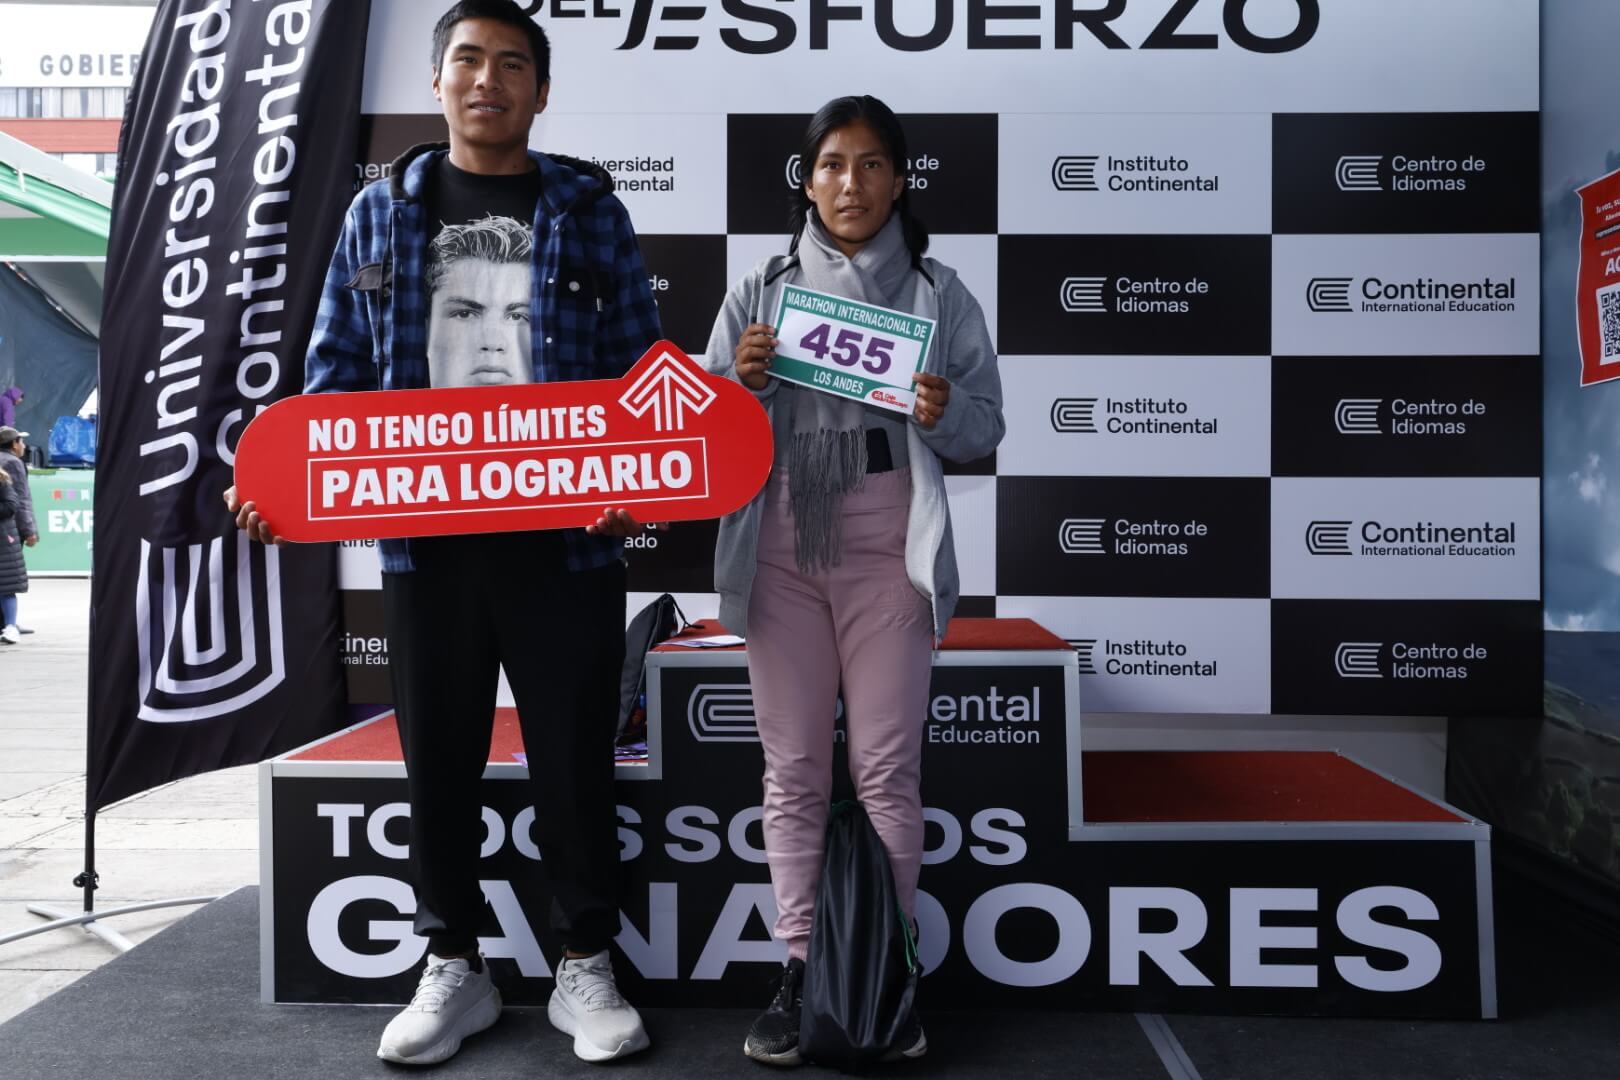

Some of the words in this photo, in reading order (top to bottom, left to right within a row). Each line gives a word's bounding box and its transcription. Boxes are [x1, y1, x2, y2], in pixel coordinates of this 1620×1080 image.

[613, 0, 1320, 54] ESFUERZO
[916, 155, 939, 170] de
[1109, 156, 1188, 171] Instituto
[1392, 156, 1457, 171] Centro
[1462, 156, 1485, 171] de
[613, 176, 674, 191] inental
[1108, 175, 1218, 191] Continental
[1393, 175, 1465, 190] Idiomas
[137, 0, 231, 496] Universidad
[1117, 277, 1180, 293] Centro
[1185, 278, 1208, 293] de
[1362, 278, 1514, 299] Continental
[1117, 297, 1188, 312] Idiomas
[1362, 301, 1445, 312] International
[1449, 301, 1514, 311] Education
[786, 291, 836, 314] MARATHON
[837, 305, 912, 335] INTERNACIONAL
[913, 325, 928, 339] DE
[800, 323, 895, 375] 455
[813, 369, 833, 385] LOS
[832, 374, 864, 395] ANDES
[1107, 398, 1187, 413] Instituto
[1392, 399, 1457, 415] Centro
[1462, 399, 1485, 414] de
[309, 418, 356, 451] NO
[367, 412, 472, 448] TENGO
[484, 404, 606, 442] LÍMITES
[1107, 418, 1217, 433] Continental
[1393, 419, 1465, 434] Idiomas
[323, 465, 449, 507] PARA
[460, 450, 692, 501] LOGRARLO
[1115, 519, 1179, 535] Centro
[1184, 520, 1207, 535] de
[1362, 521, 1515, 543] Continental
[1116, 539, 1187, 554] Idiomas
[1362, 545, 1445, 555] International
[1449, 545, 1515, 556] Education
[1106, 640, 1186, 656] Instituto
[1393, 643, 1458, 658] Centro
[1463, 643, 1486, 658] de
[1106, 659, 1216, 676] Continental
[1393, 663, 1467, 678] Idiomas
[929, 725, 1039, 743] Education
